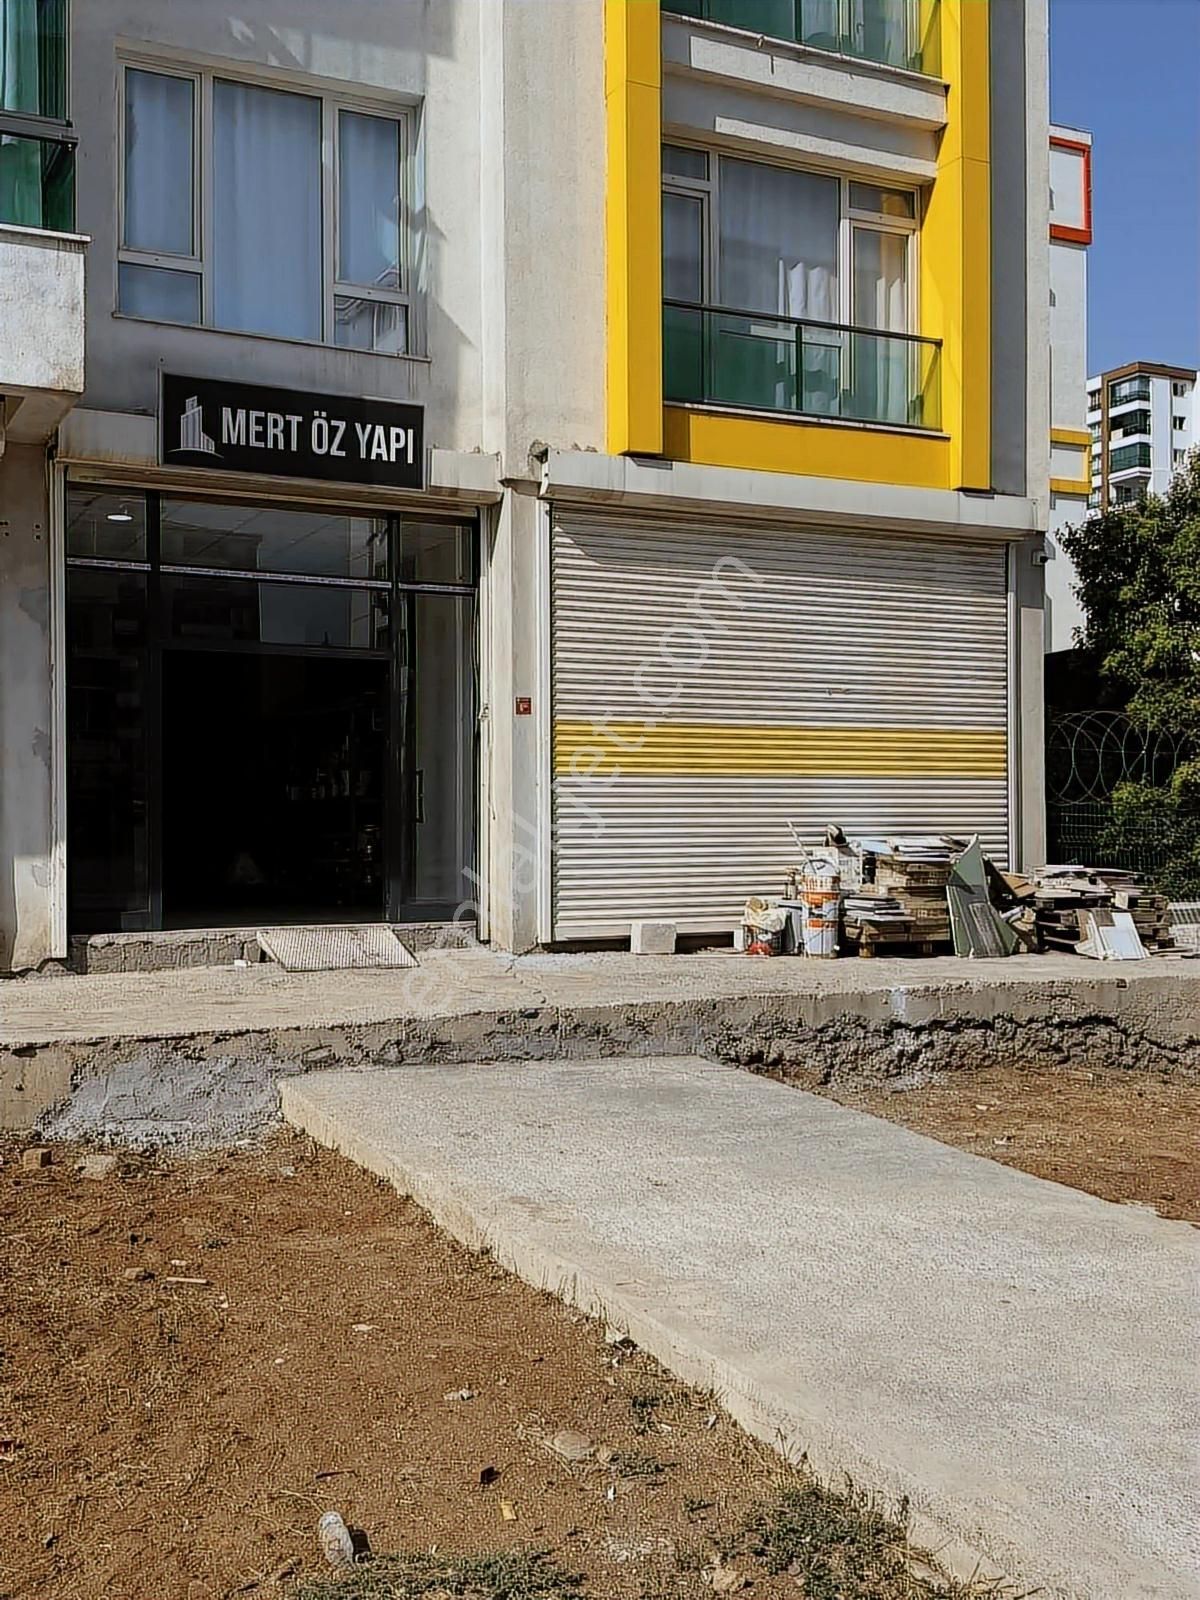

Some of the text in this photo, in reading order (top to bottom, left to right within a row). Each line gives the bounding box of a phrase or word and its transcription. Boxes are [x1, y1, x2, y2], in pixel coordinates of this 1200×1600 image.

[222, 406, 414, 464] MERT ÖZ YAPI
